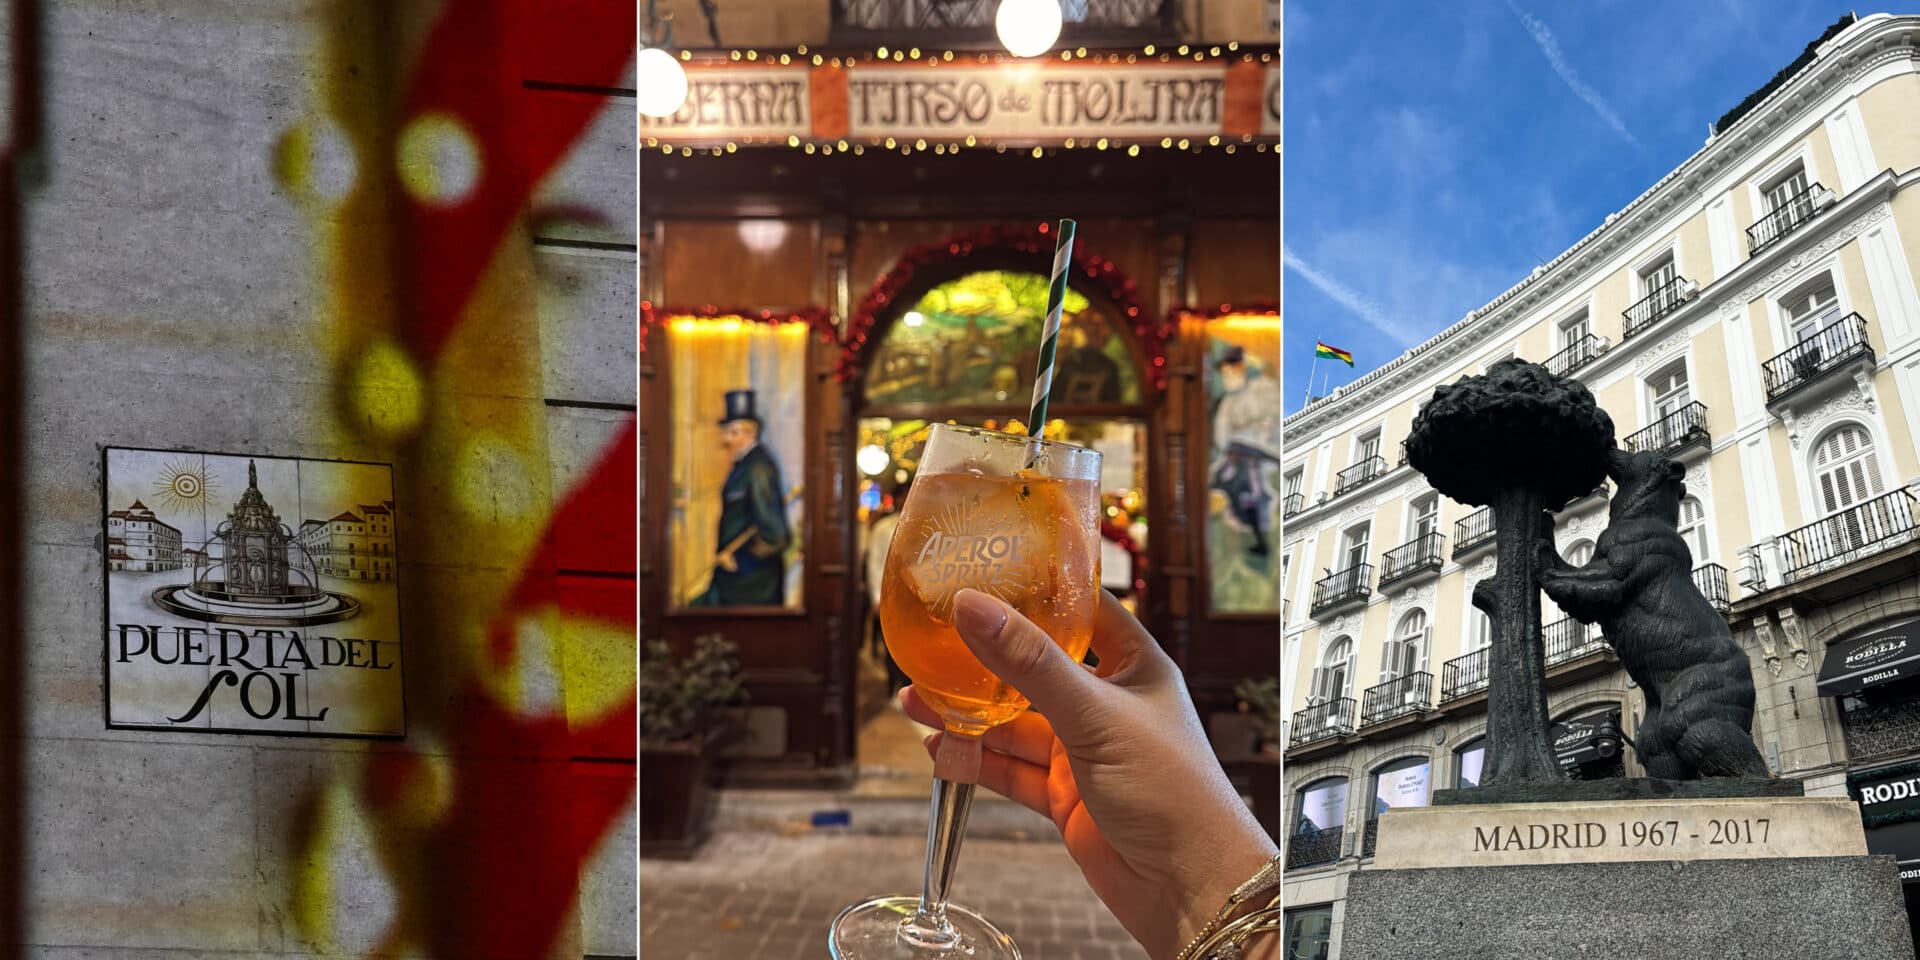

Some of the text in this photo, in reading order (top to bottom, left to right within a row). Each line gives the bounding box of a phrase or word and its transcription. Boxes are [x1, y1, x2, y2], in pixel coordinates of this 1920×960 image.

[998, 84, 1032, 112] de
[1040, 78, 1224, 125] MOLINA
[917, 531, 1024, 566] APEROL
[116, 623, 393, 671] PUERTA DEL
[1845, 640, 1907, 664] RODILLA
[1862, 669, 1899, 685] RODILLA
[167, 670, 329, 723] SOL
[1861, 778, 1920, 805] RODI
[1472, 822, 1607, 852] MADRID
[1618, 820, 1679, 847] 1967
[1708, 819, 1770, 845] 2017
